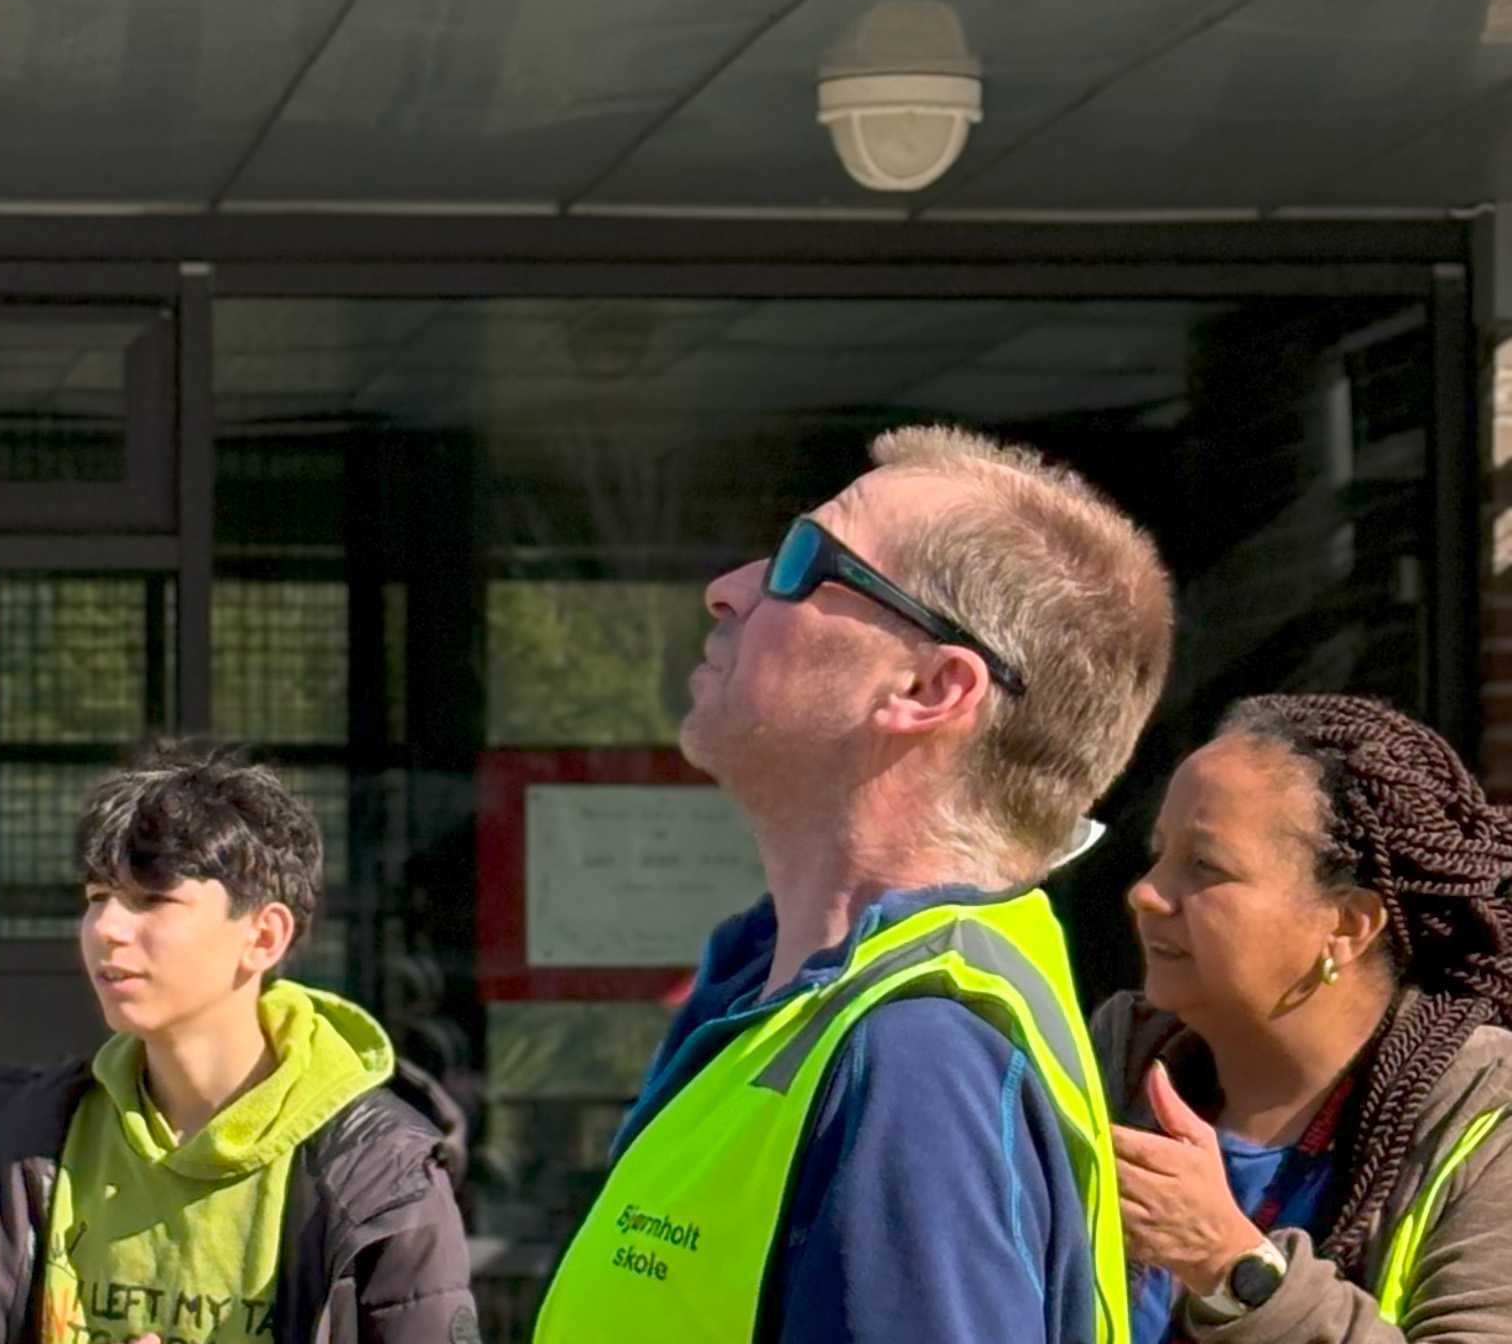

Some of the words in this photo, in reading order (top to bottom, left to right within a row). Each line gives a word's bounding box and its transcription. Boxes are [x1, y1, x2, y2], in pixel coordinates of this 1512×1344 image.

[615, 1203, 700, 1251] Bjørnholt
[612, 1244, 668, 1281] skole
[92, 1282, 165, 1323] LEFT
[173, 1290, 232, 1331] MY
